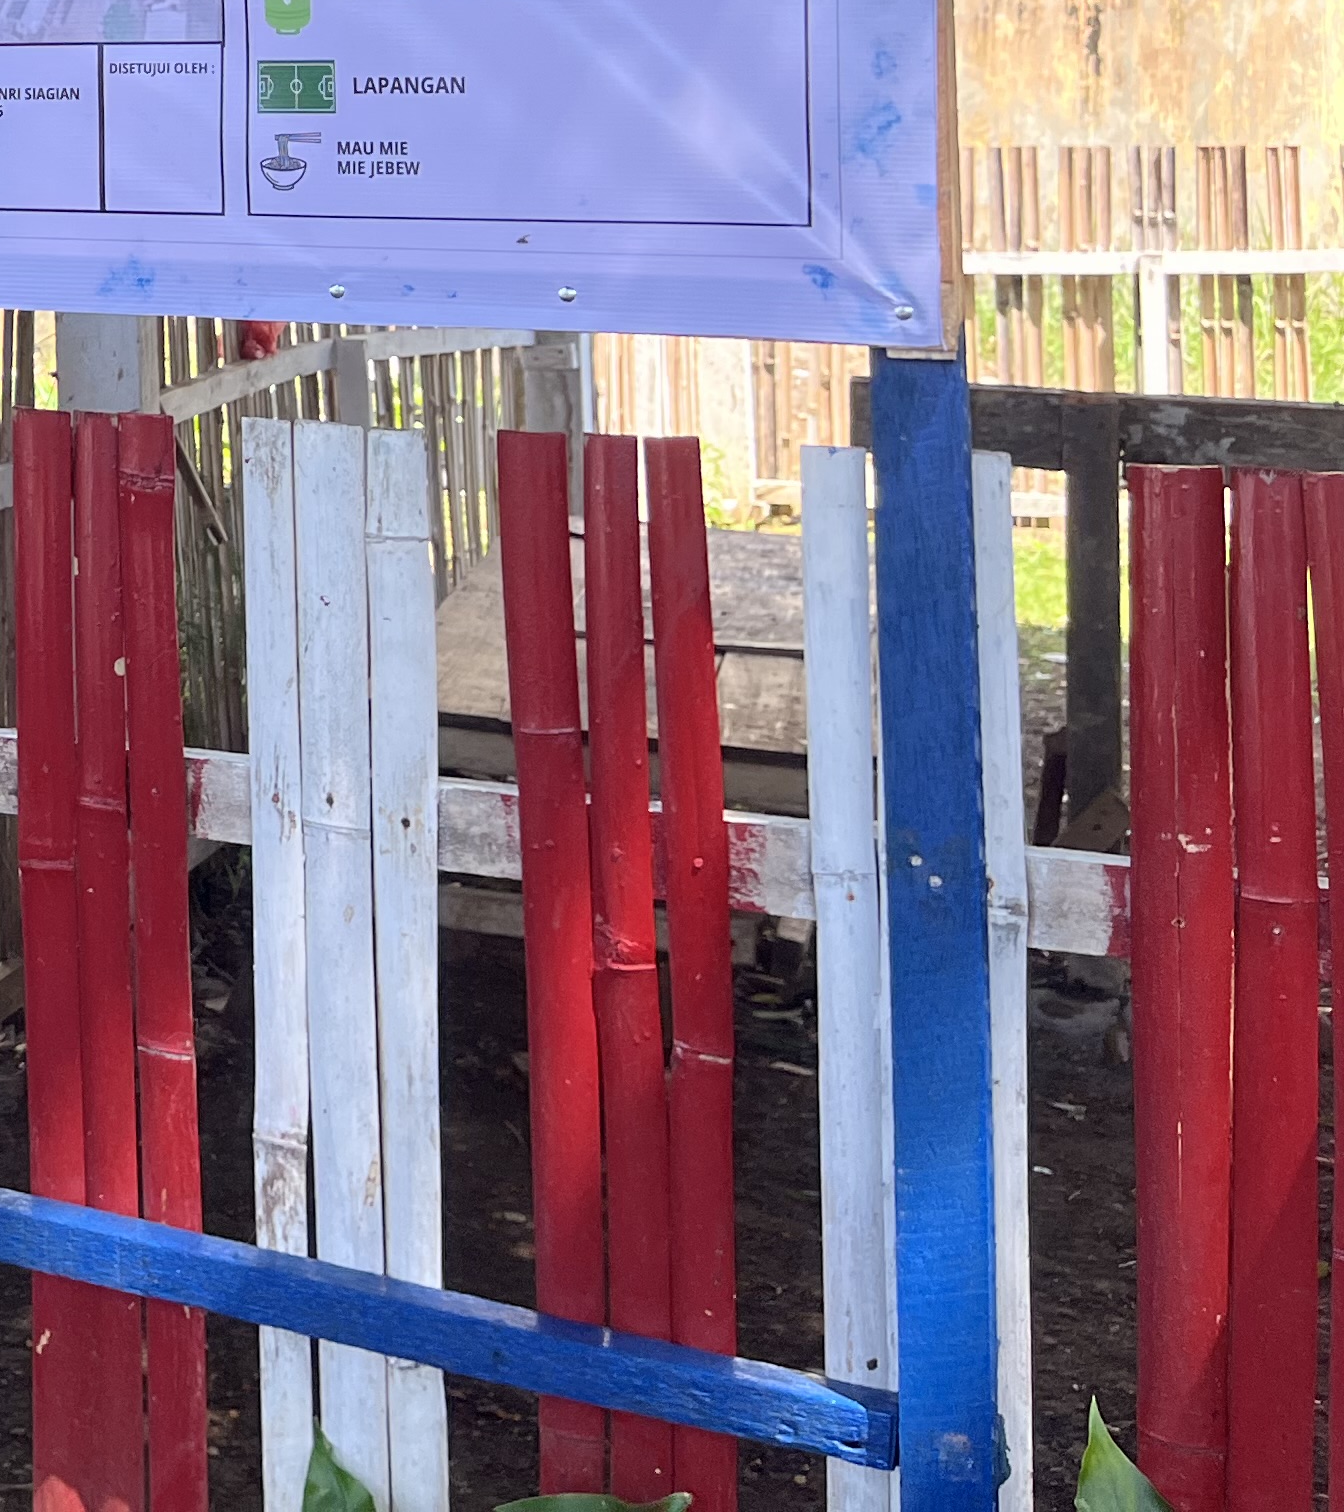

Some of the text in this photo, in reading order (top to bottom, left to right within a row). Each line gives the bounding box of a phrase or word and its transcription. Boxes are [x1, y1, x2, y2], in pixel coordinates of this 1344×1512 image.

[109, 63, 207, 77] DISETUJUI OLEH
[353, 77, 465, 94] LAPANGAN
[25, 88, 79, 100] SIAGIAN
[337, 141, 408, 155] MAU MIE
[337, 161, 420, 179] MIE JEBEW
